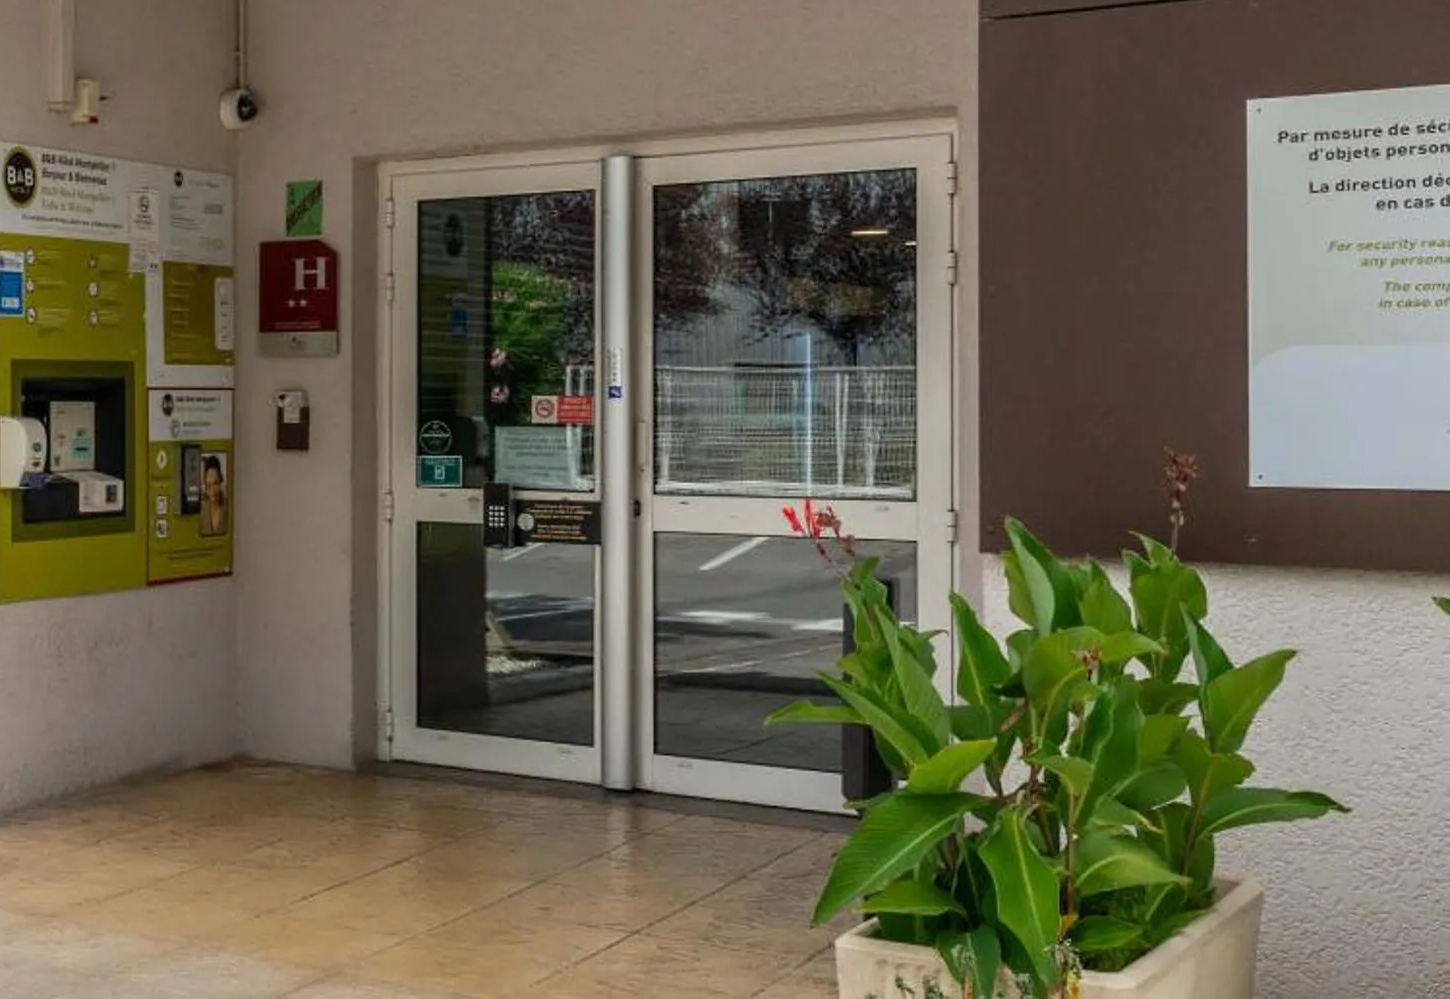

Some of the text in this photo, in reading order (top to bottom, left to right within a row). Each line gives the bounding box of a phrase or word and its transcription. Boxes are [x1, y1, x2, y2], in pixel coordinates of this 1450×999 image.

[1277, 118, 1450, 144] Par mesure de séc
[1308, 146, 1381, 162] d'objets
[1308, 180, 1330, 194] La
[1335, 176, 1417, 192] direction
[1375, 199, 1399, 211] en
[1403, 197, 1435, 209] cas
[1328, 240, 1352, 252] For
[1356, 238, 1416, 251] security
[1361, 257, 1386, 269] any
[294, 256, 329, 290] H
[1385, 281, 1411, 292] The
[1396, 298, 1431, 308] case
